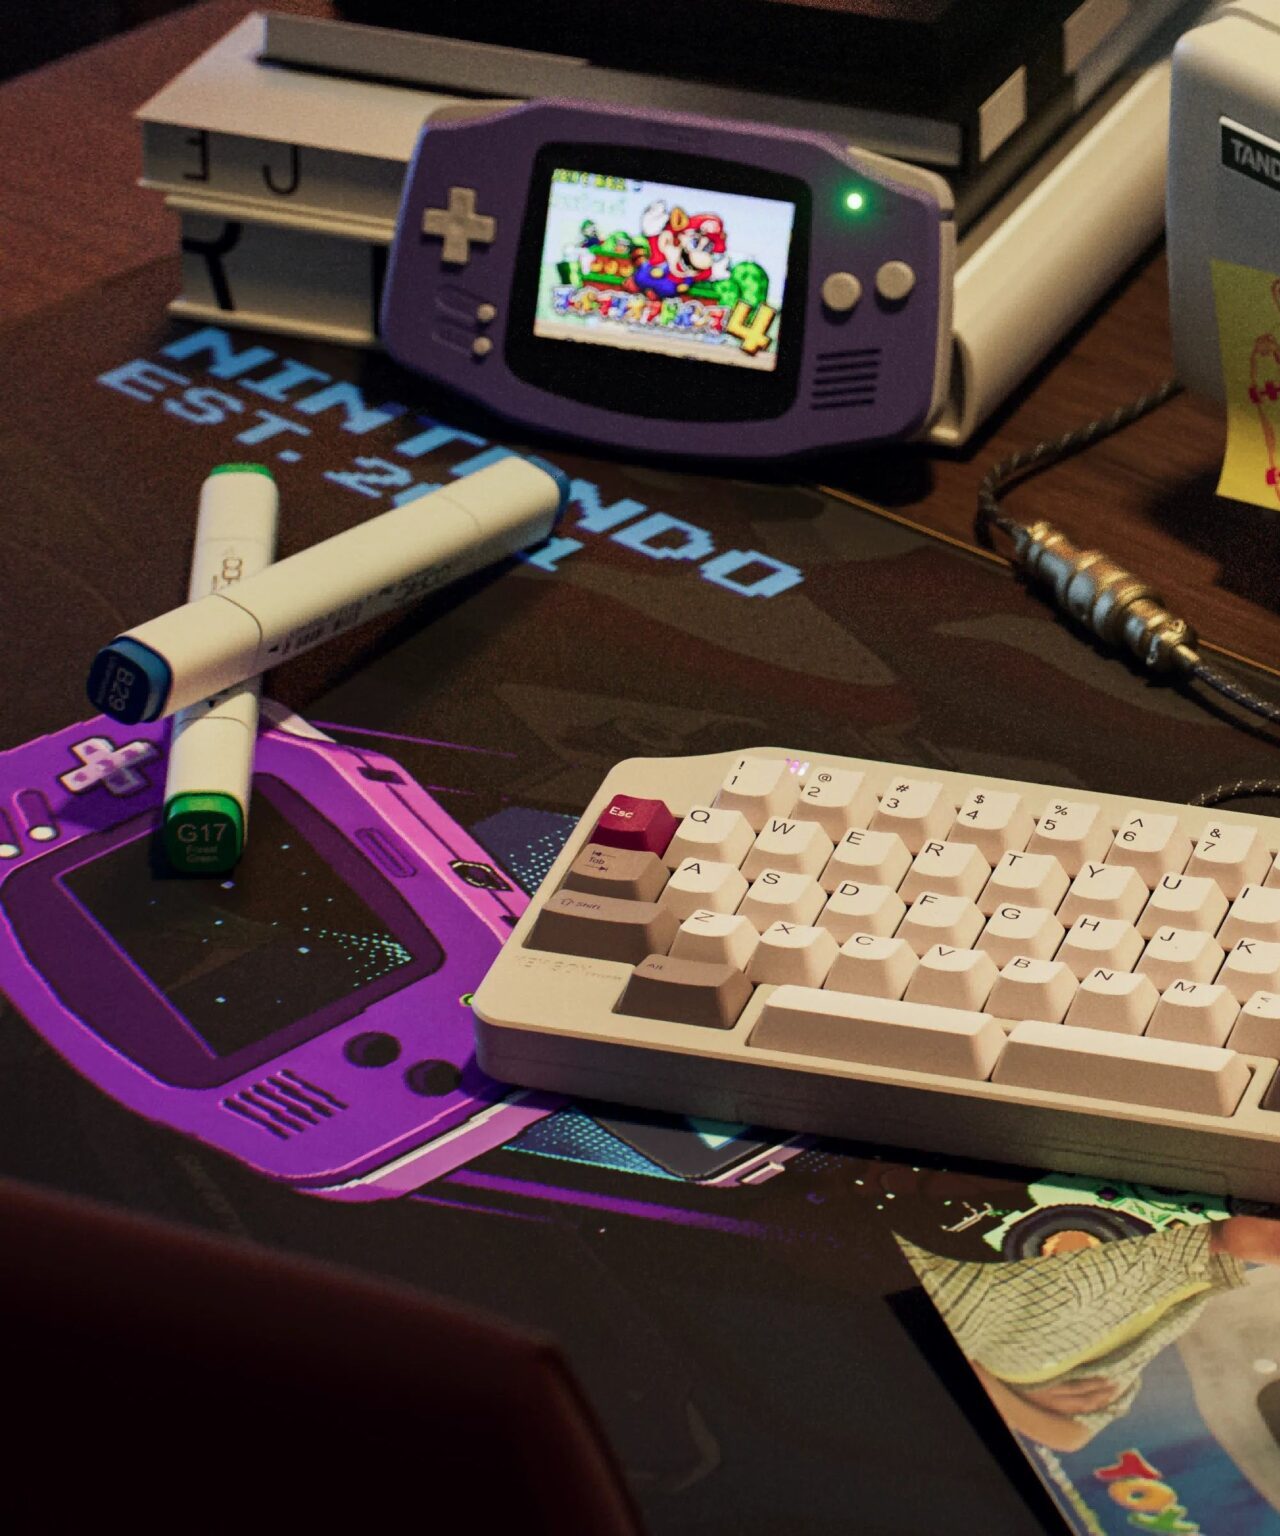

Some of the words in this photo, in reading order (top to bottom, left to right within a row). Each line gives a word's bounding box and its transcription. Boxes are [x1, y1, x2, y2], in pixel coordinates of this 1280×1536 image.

[97, 358, 312, 463] EST.
[324, 456, 584, 572] 21
[160, 326, 804, 598] NINTNDO
[731, 775, 738, 785] 1
[818, 773, 832, 784] @
[807, 786, 821, 798] 2
[896, 783, 909, 793] #
[886, 798, 900, 809] 3
[974, 794, 985, 805] $
[609, 806, 634, 819] Esc
[966, 809, 979, 821] 4
[1055, 804, 1068, 816] %
[690, 809, 711, 825] Q
[771, 820, 795, 835] W
[1044, 819, 1056, 831] 5
[177, 823, 228, 843] G17
[846, 832, 865, 846] E
[1122, 830, 1137, 842] 6
[1209, 828, 1222, 839] &
[924, 842, 944, 857] R
[1202, 841, 1216, 852] 7
[589, 856, 605, 865] Tab
[1007, 853, 1023, 867] T
[683, 862, 702, 875] A
[1087, 864, 1104, 878] Y
[762, 872, 782, 885] S
[1162, 876, 1182, 890] U
[839, 883, 860, 897] D
[1242, 887, 1250, 899] I
[577, 901, 600, 910] Shift
[919, 894, 939, 906] F
[694, 911, 714, 923] Z
[1001, 907, 1021, 920] G
[773, 923, 796, 935] X
[1079, 918, 1100, 932] H
[855, 935, 875, 946] C
[1160, 931, 1176, 942] J
[937, 946, 957, 957] V
[1237, 940, 1256, 954] K
[1013, 958, 1031, 969] B
[1094, 969, 1114, 981] N
[1174, 981, 1196, 994] M
[1094, 1448, 1201, 1536] TOY
